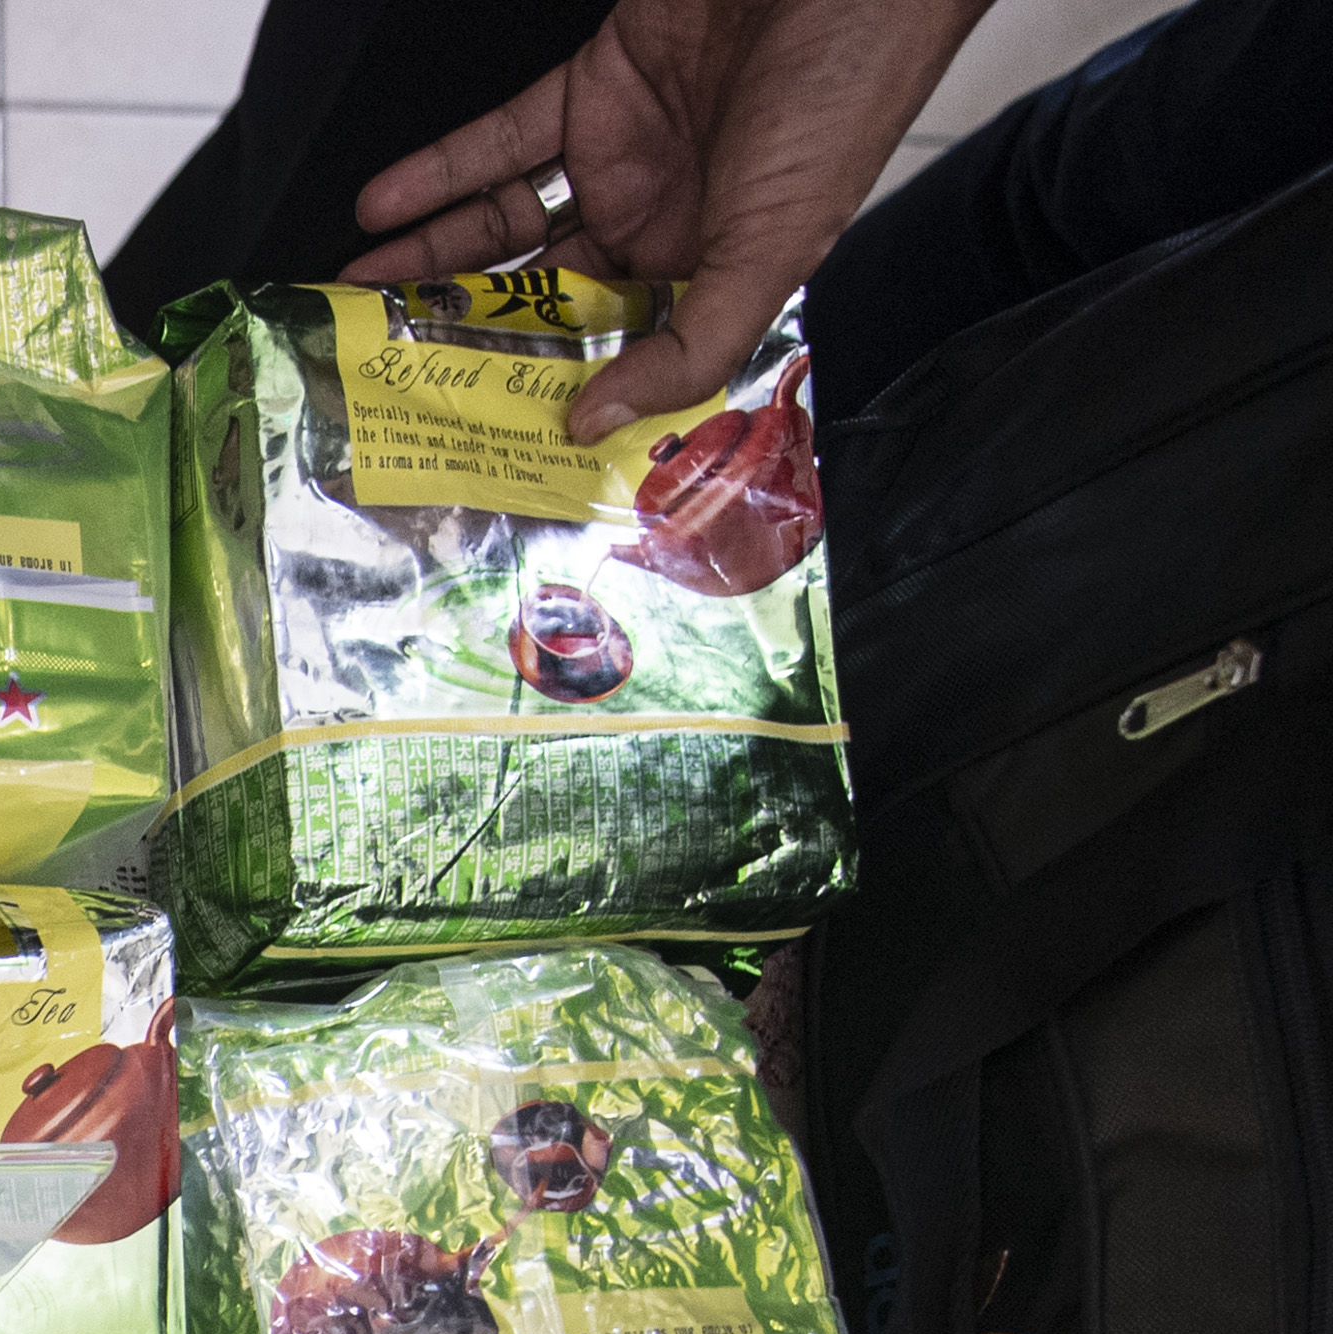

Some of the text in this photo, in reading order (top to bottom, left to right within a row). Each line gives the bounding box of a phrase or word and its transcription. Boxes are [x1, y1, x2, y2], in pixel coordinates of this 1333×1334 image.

[359, 347, 491, 393] Refined
[379, 455, 413, 470] aroma
[11, 988, 77, 1026] Tea
